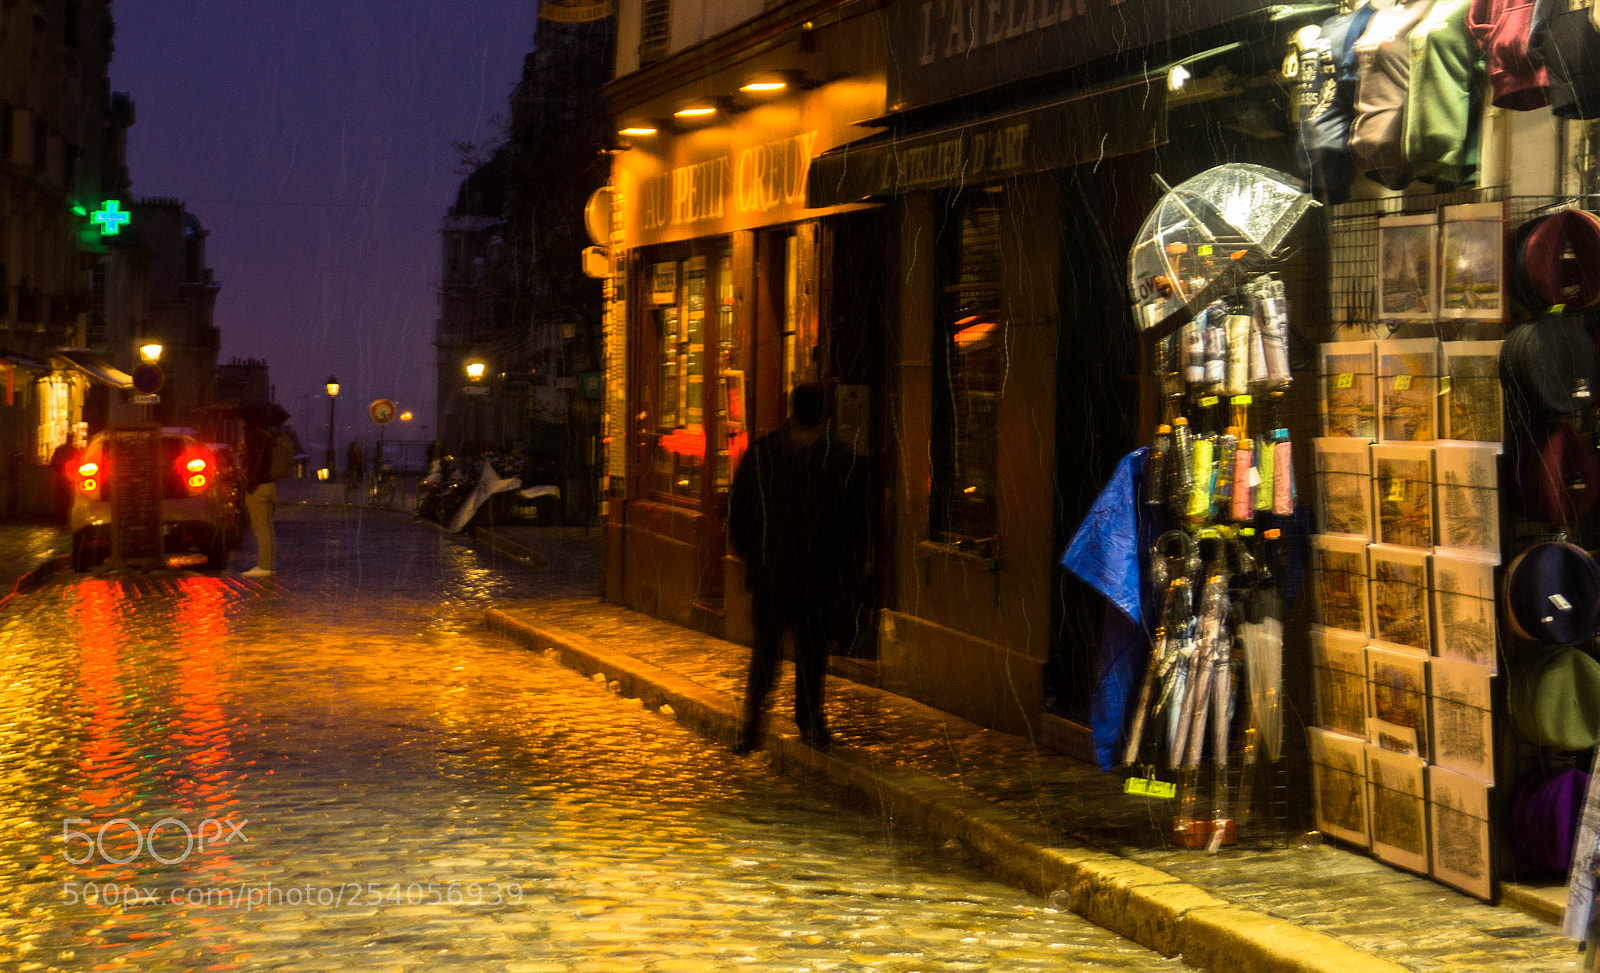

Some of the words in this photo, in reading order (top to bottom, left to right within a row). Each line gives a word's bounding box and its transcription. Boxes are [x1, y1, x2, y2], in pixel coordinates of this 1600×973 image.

[921, 0, 1087, 66] L'ATEL
[644, 171, 670, 229] AU
[671, 155, 727, 225] PETIT
[733, 130, 818, 213] CREUX
[972, 123, 1029, 174] D'ART
